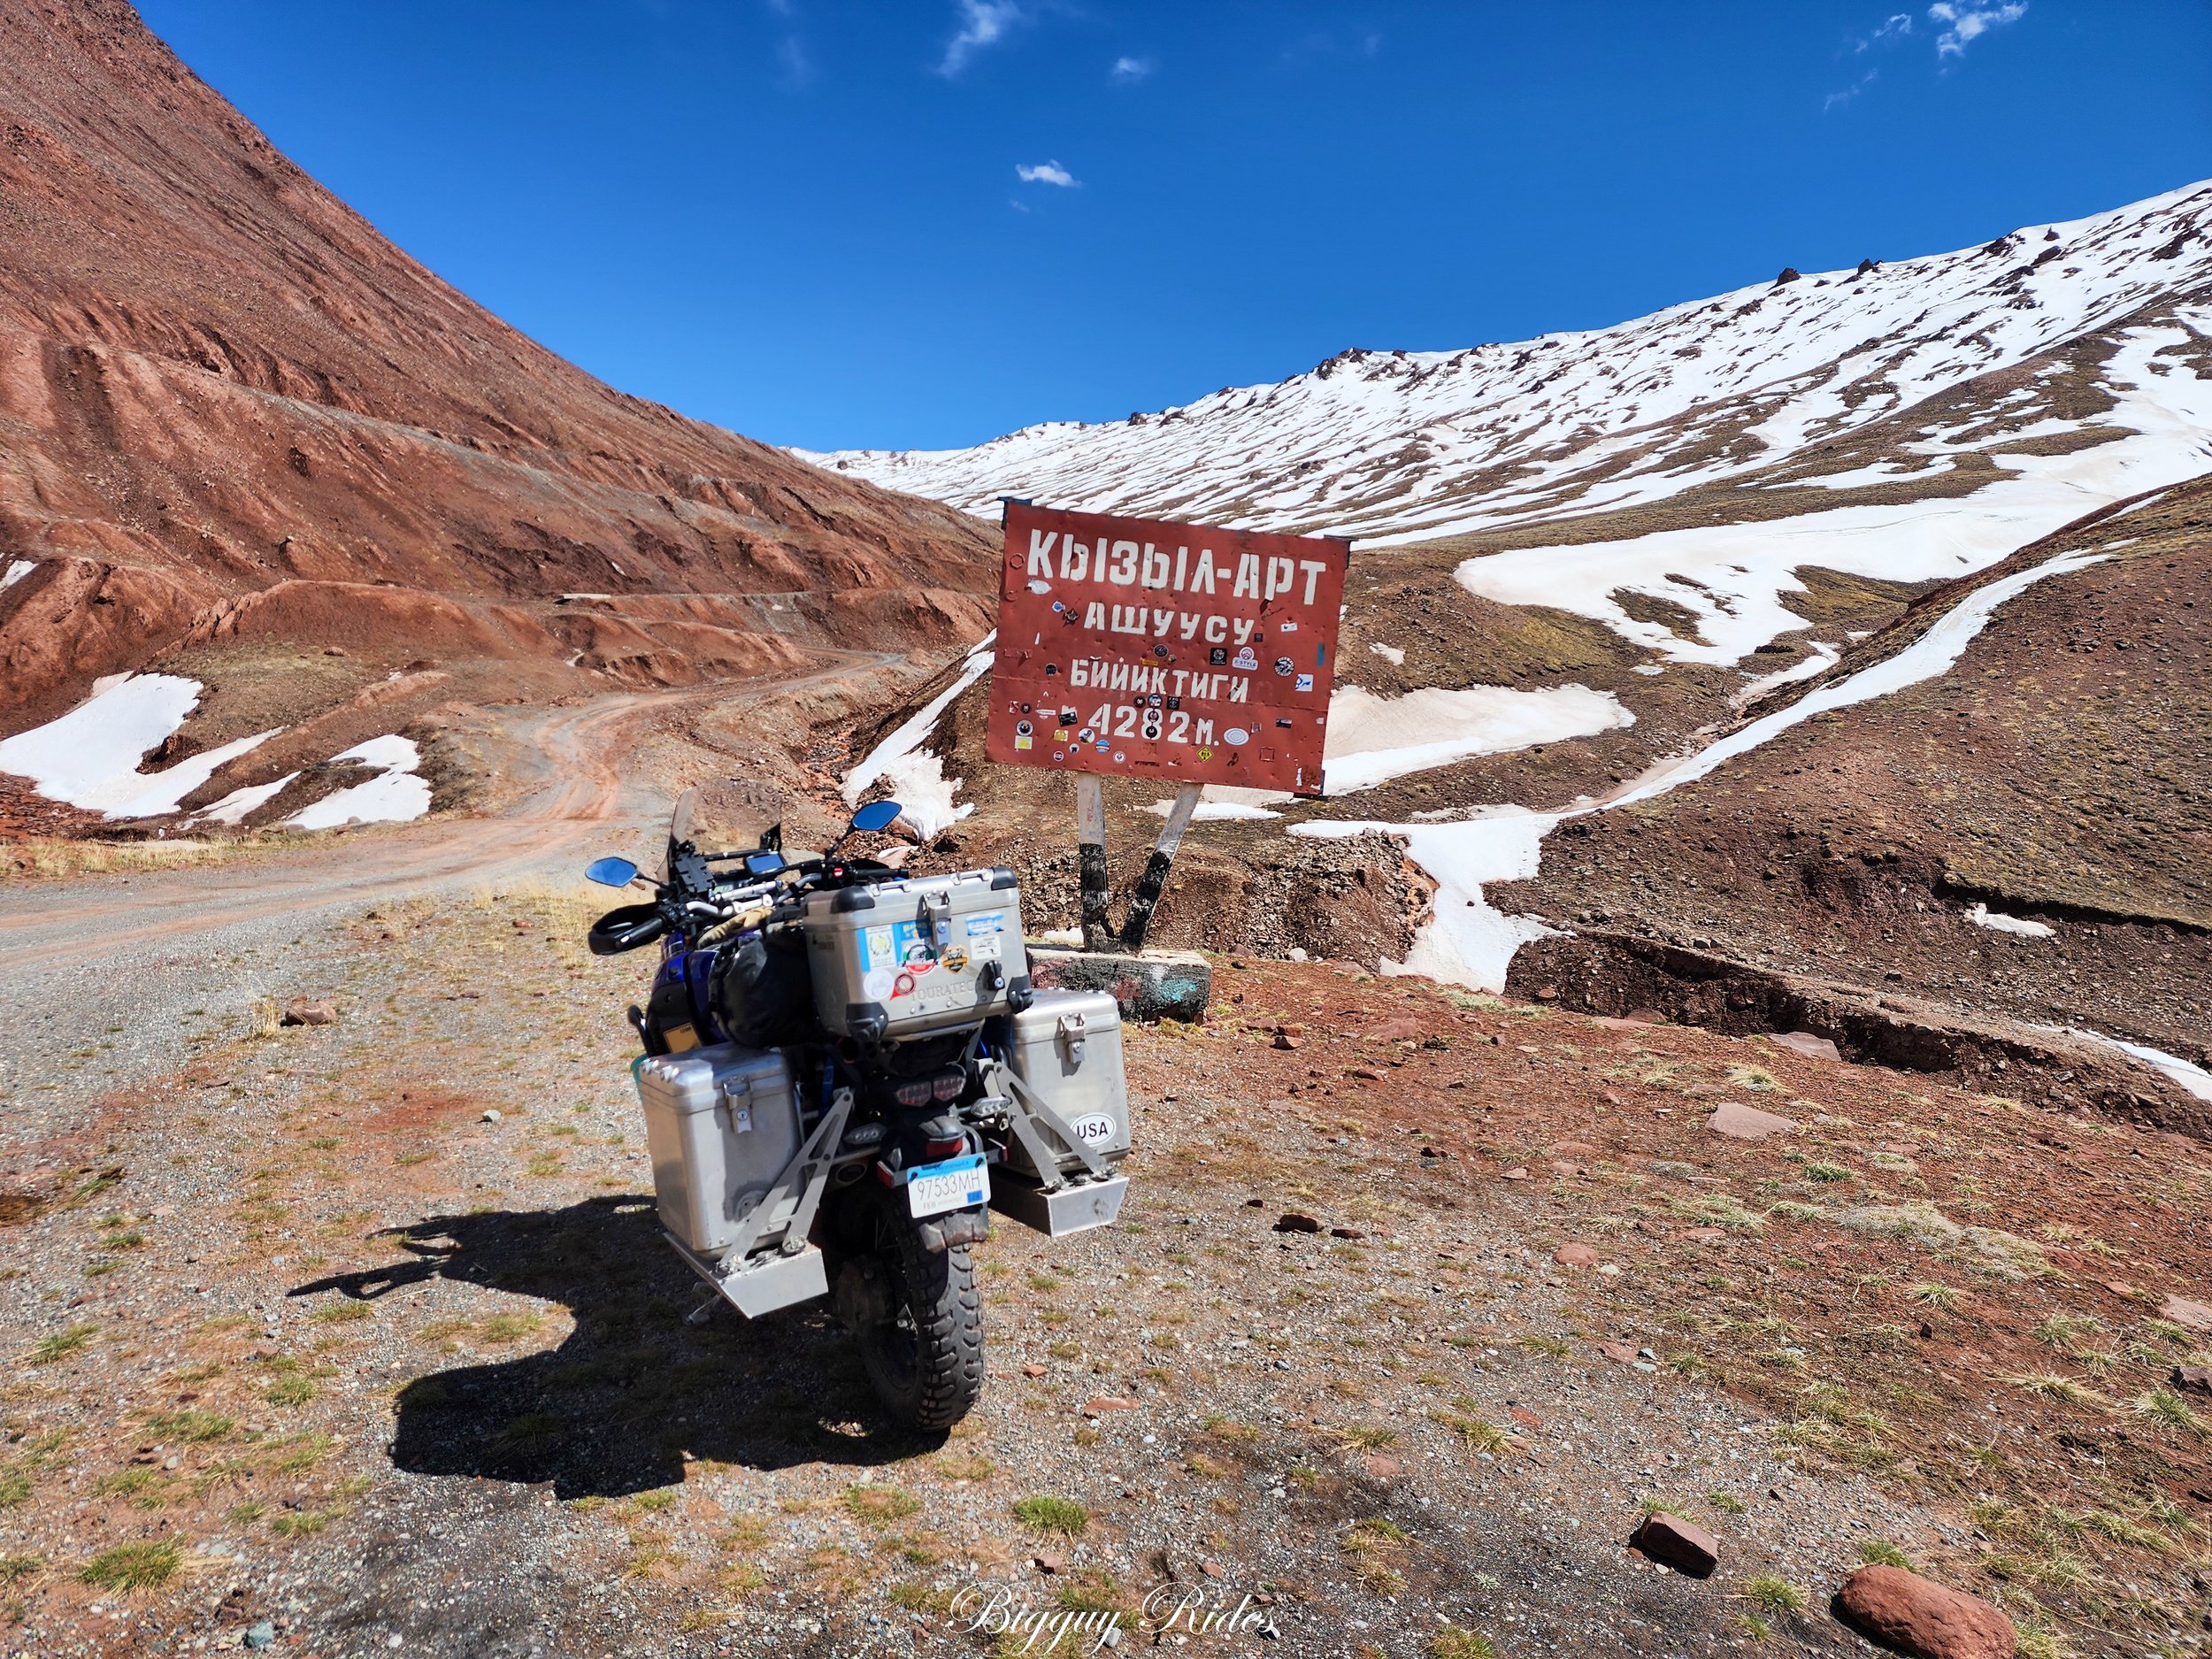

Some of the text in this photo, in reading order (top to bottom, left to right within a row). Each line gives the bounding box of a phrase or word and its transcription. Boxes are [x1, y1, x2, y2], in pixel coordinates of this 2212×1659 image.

[1026, 528, 1327, 606] КЫЗЫЛ-АРТ
[1083, 601, 1255, 646] АШУУСУ
[910, 979, 976, 1002] TOURATEC
[1076, 1121, 1109, 1140] USA
[917, 1168, 981, 1202] 97533MH
